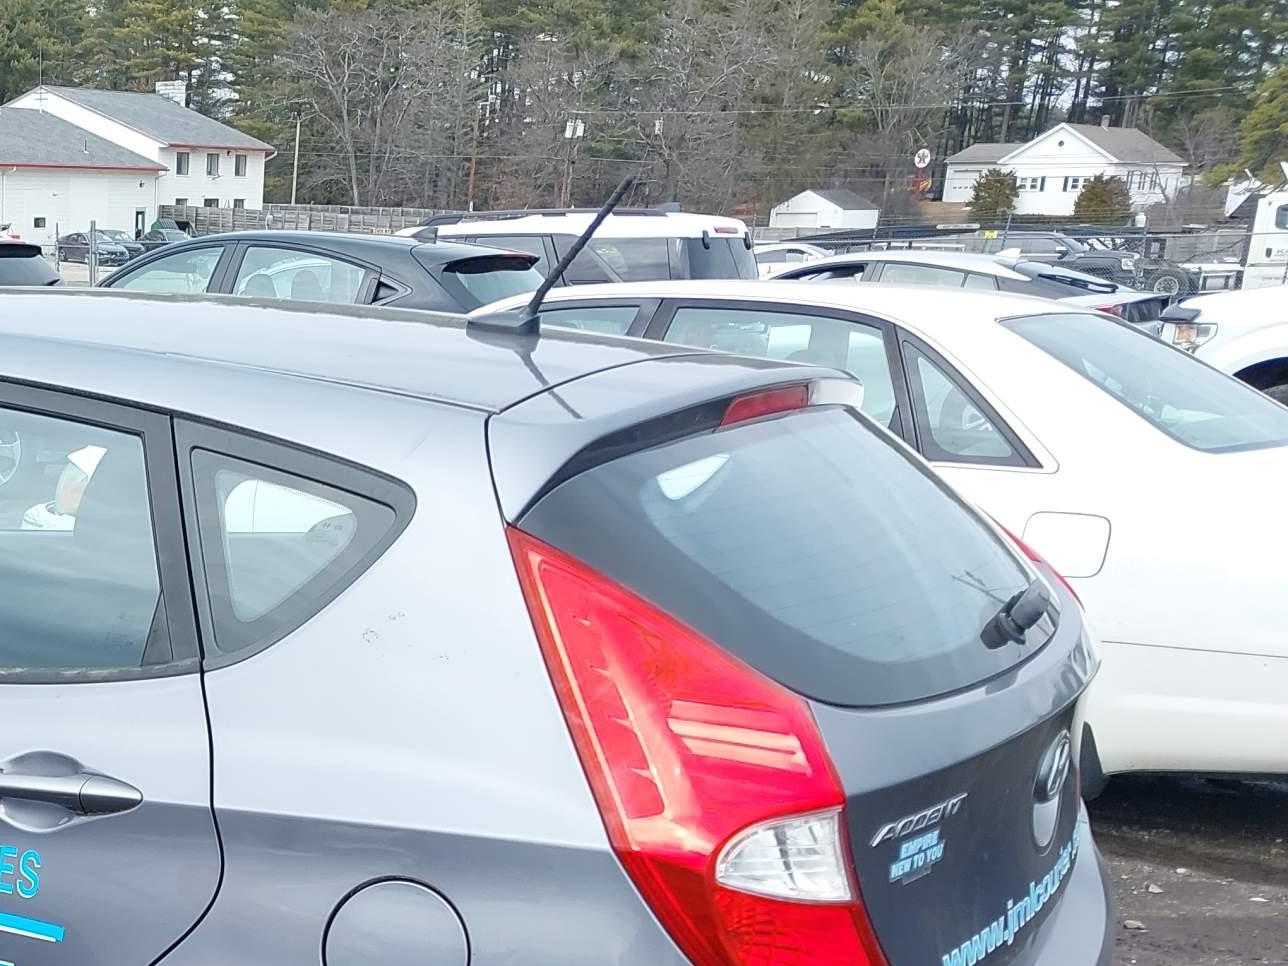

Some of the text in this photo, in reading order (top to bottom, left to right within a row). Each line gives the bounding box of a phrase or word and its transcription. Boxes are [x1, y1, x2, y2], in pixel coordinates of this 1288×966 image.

[870, 792, 968, 847] ACCENT
[890, 843, 945, 879] NEW TO YOU
[900, 830, 940, 858] EMPIRE
